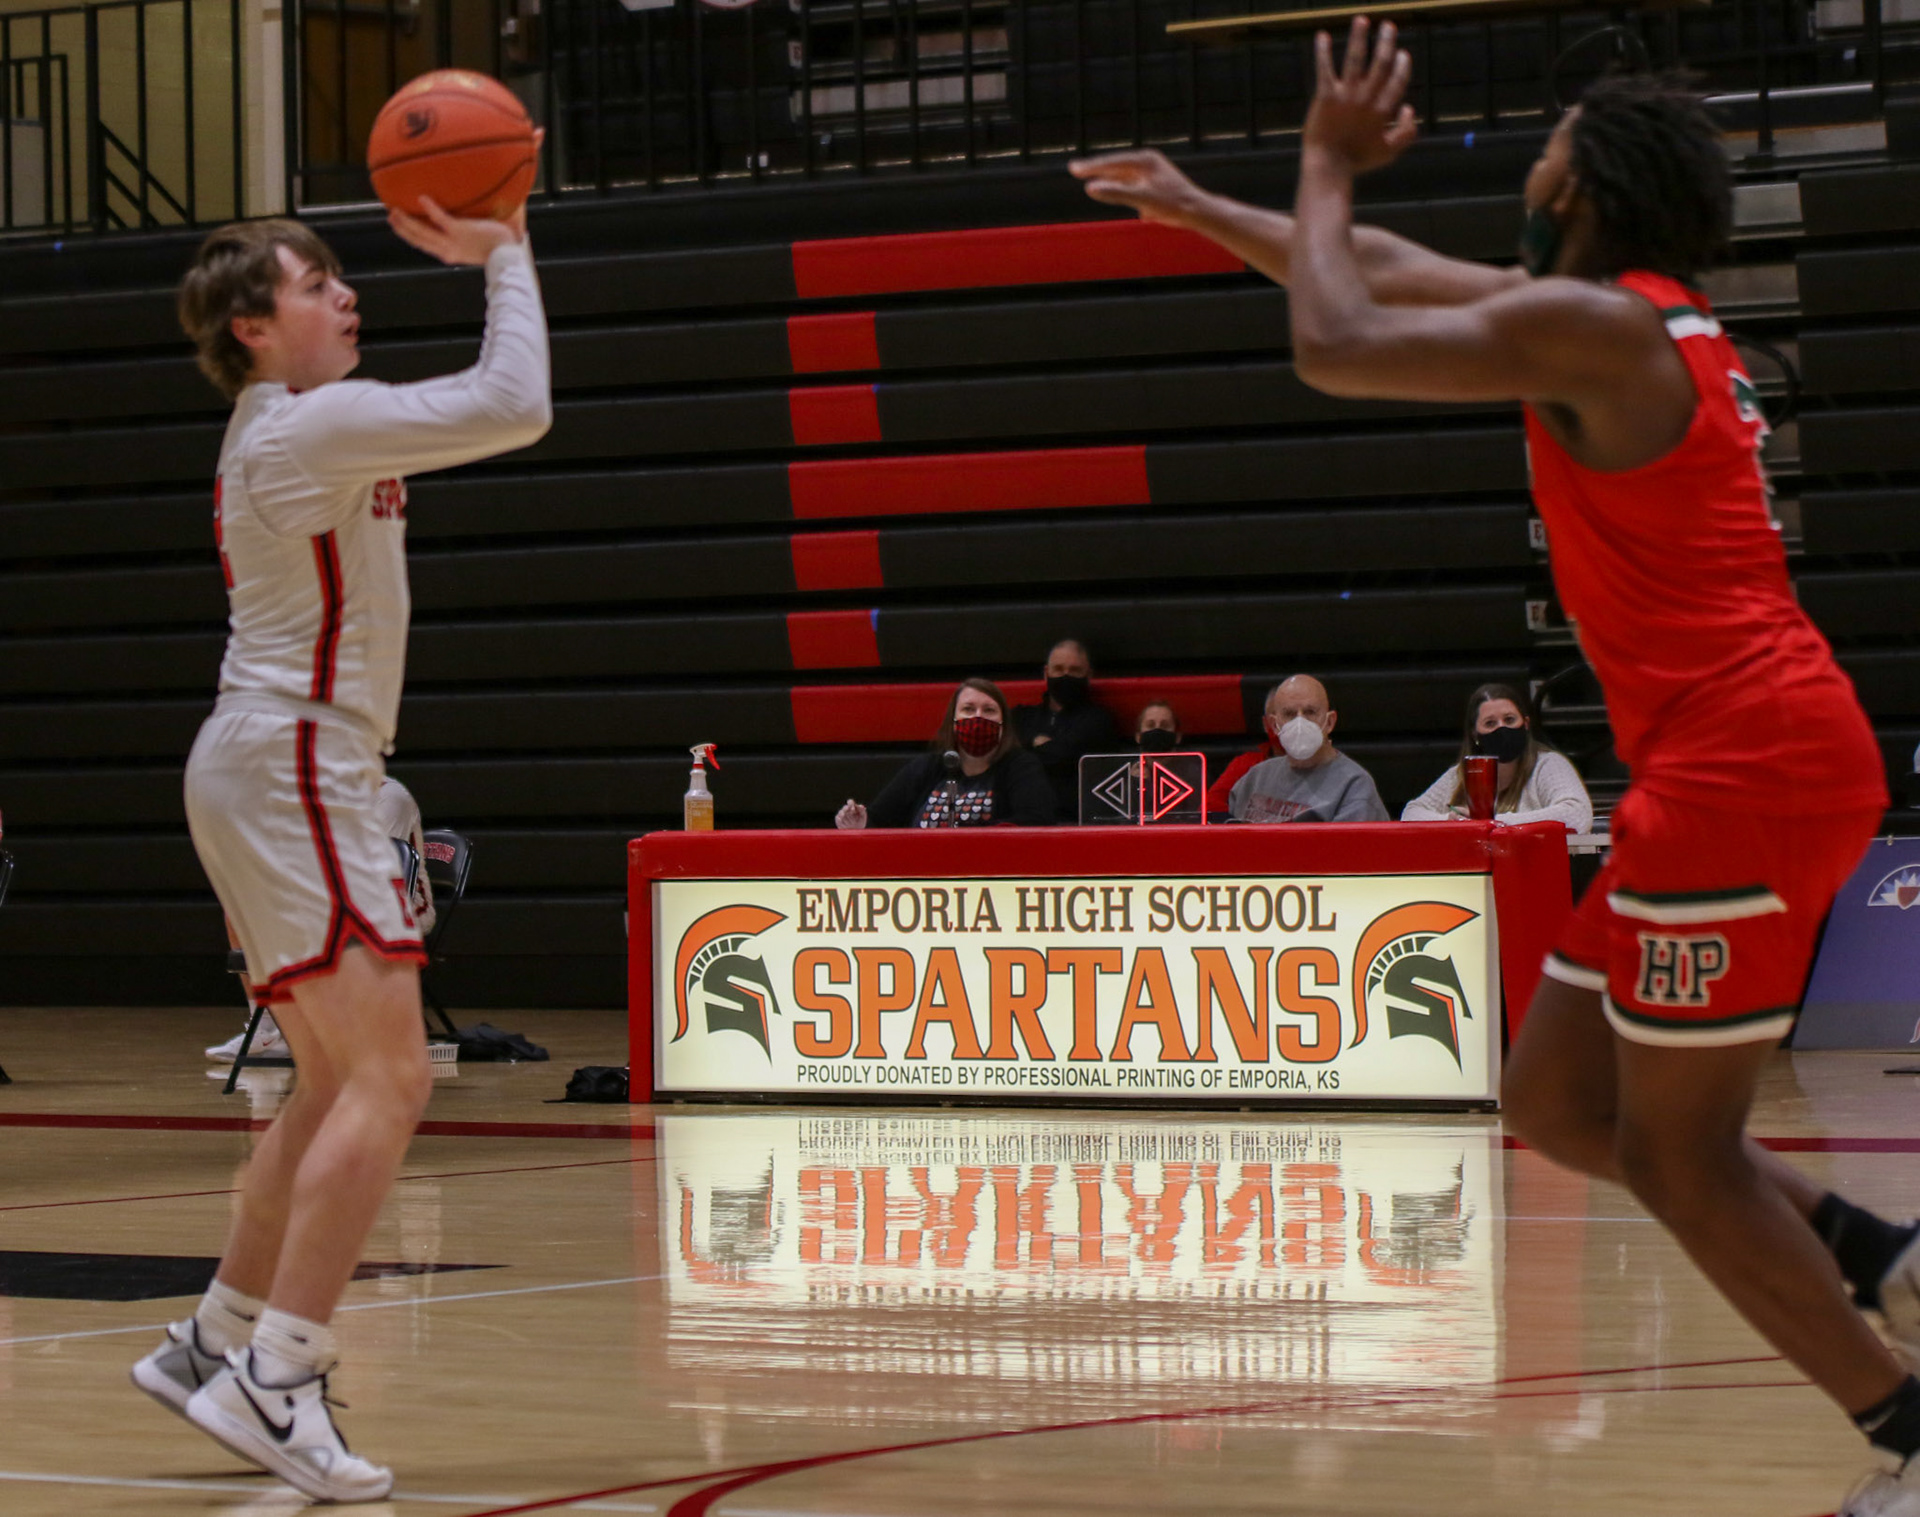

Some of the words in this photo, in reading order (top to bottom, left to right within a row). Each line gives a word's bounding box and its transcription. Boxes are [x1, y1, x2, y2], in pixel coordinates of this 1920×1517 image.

[796, 887, 1002, 933] EMPORIA
[1015, 886, 1134, 933] HIGH
[1148, 885, 1337, 933] SCHOOL
[1634, 931, 1730, 1007] HP
[793, 946, 1342, 1064] SPARTANS
[797, 1064, 871, 1084] PROUDLY
[876, 1065, 953, 1085] DONATED
[957, 1066, 980, 1085] BY
[984, 1066, 1112, 1087] PROFESSIONAL
[1117, 1068, 1196, 1088] PRINTING
[1200, 1068, 1223, 1088] OF
[1228, 1069, 1312, 1092] EMPORIA,
[1317, 1070, 1340, 1090] KS
